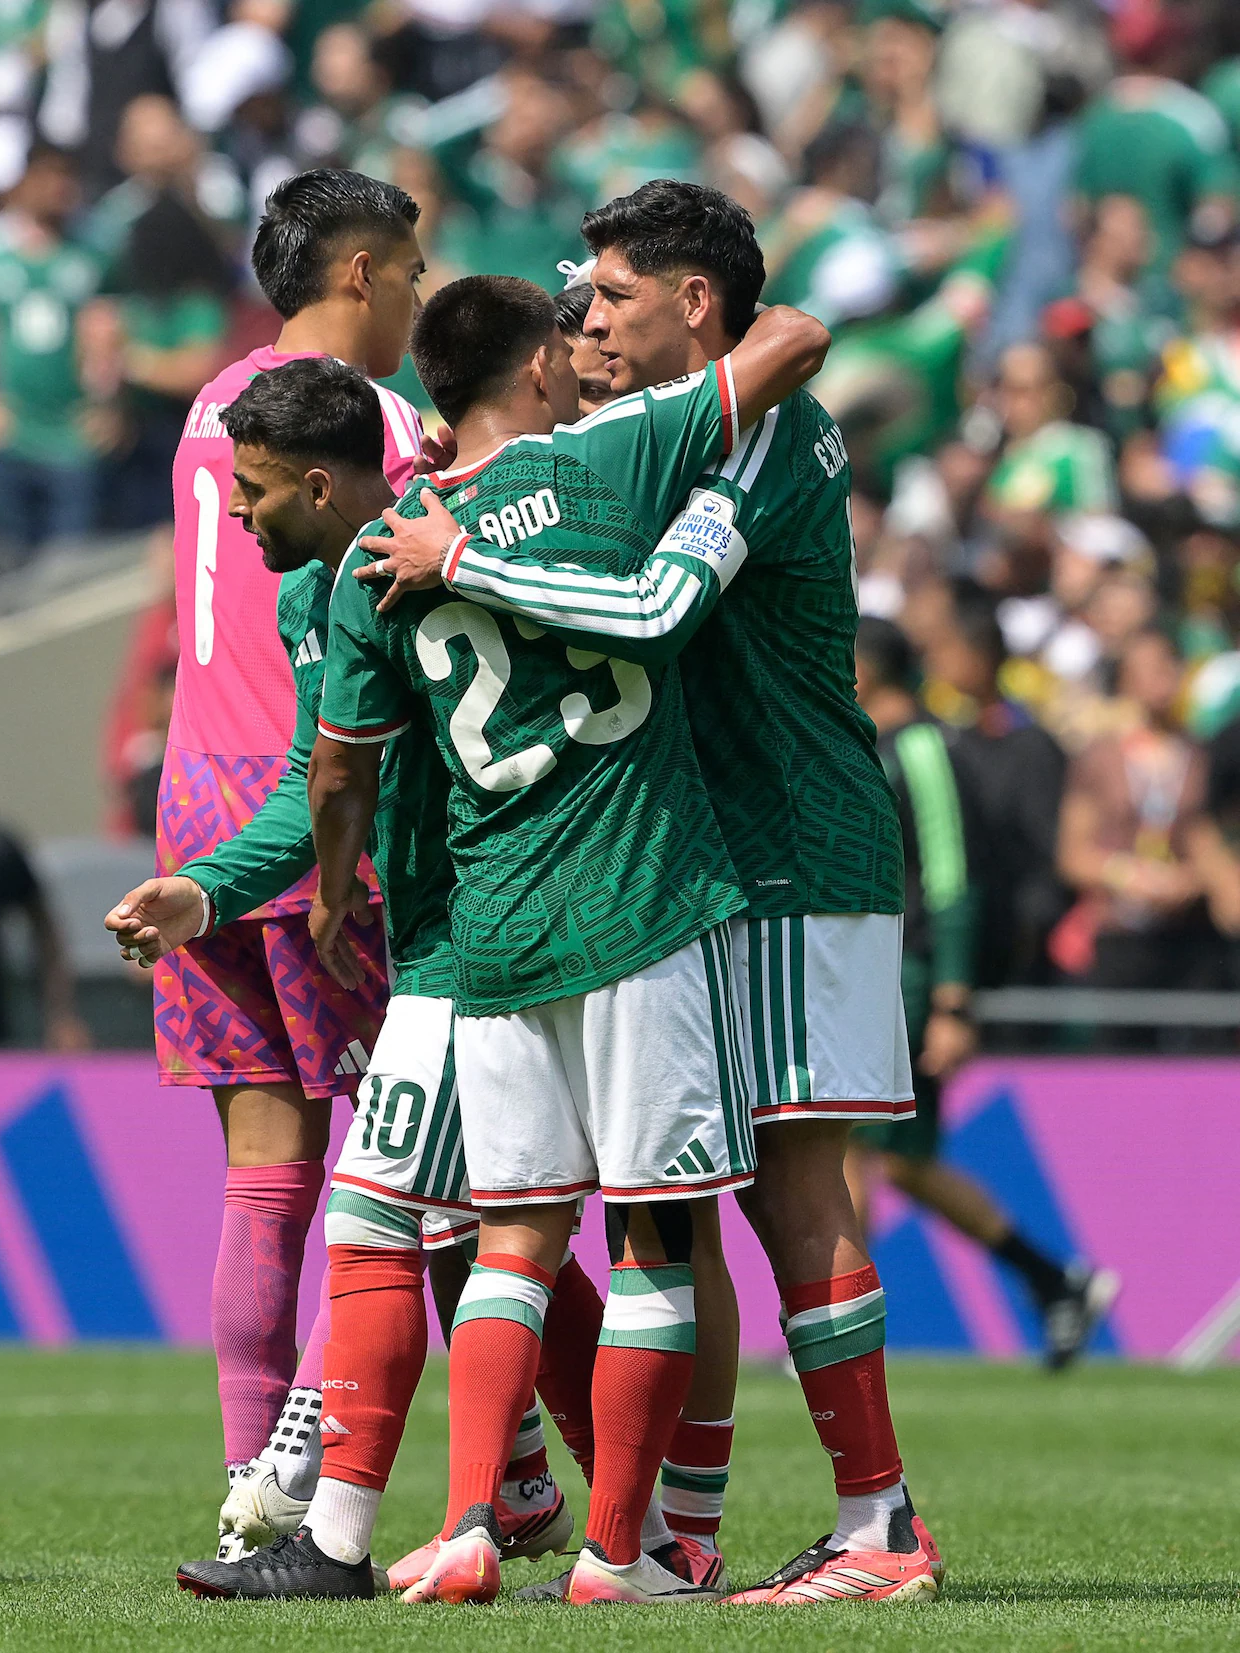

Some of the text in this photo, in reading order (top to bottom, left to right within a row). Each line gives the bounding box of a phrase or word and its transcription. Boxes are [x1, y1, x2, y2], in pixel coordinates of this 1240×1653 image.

[460, 488, 561, 549] ARDO
[682, 513, 733, 540] FOOTBALL
[675, 522, 730, 549] UNITES
[690, 534, 728, 561] World
[193, 466, 220, 666] 1
[361, 1075, 427, 1160] 10
[321, 1379, 359, 1391] XICO
